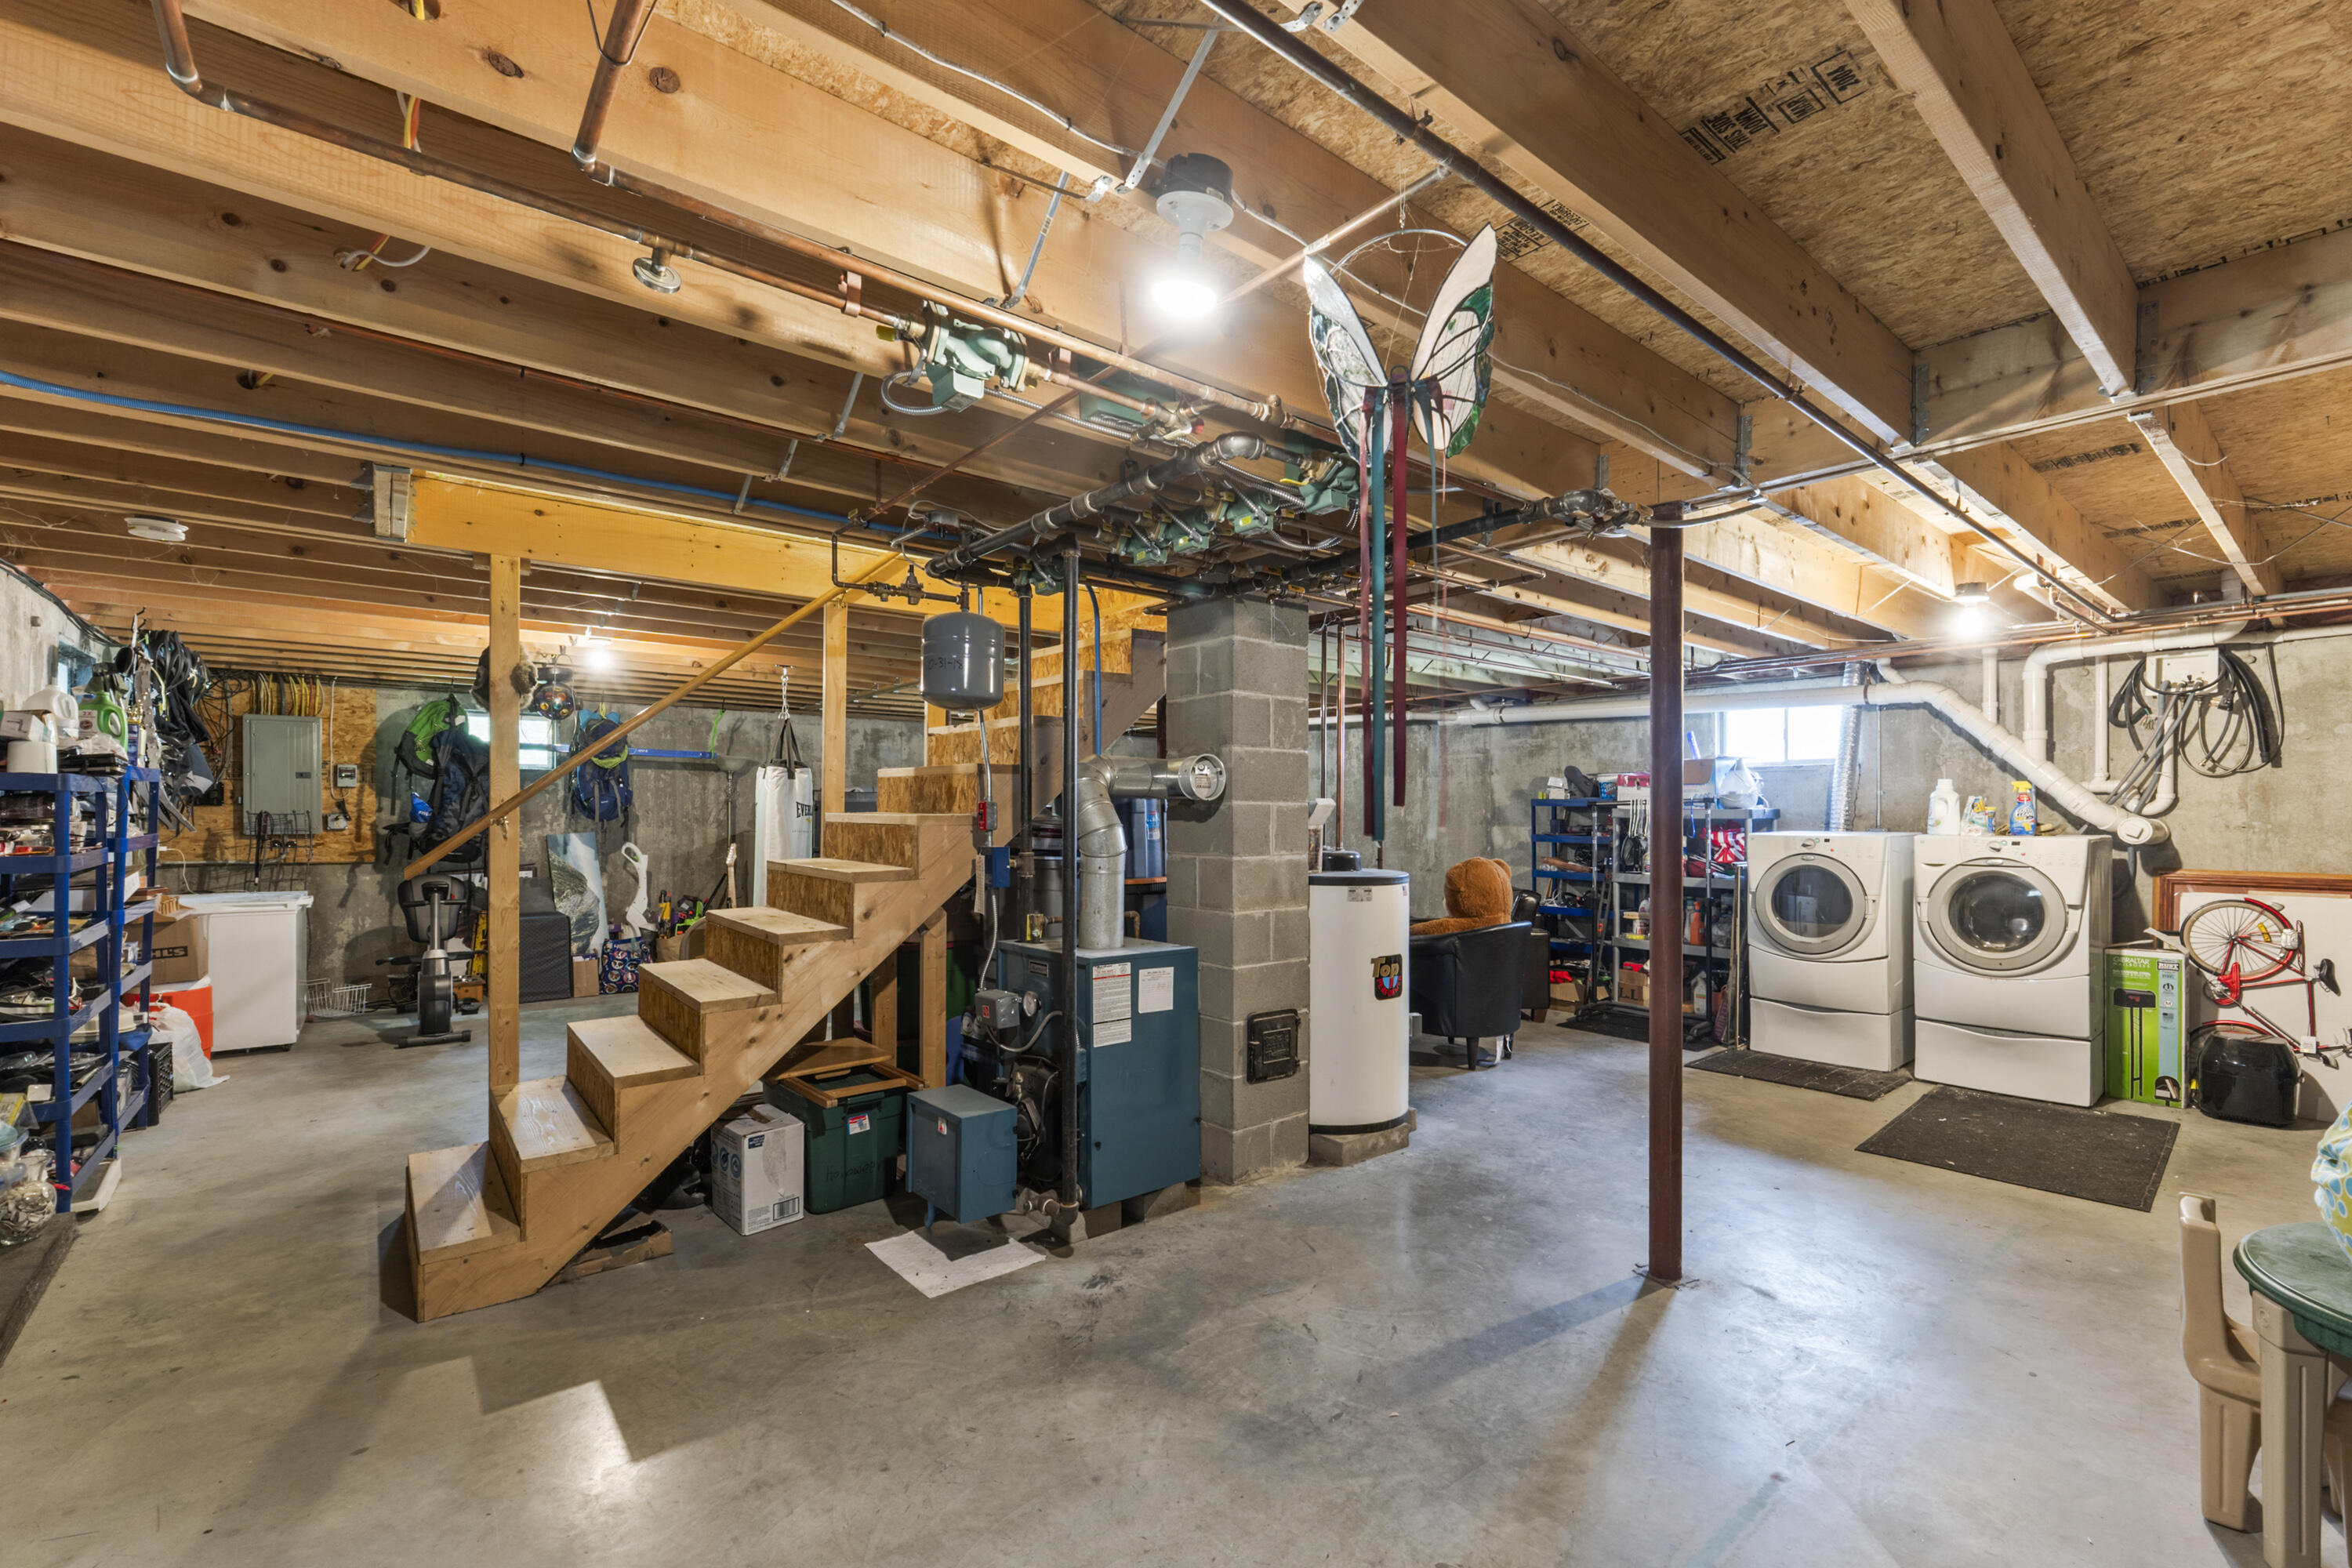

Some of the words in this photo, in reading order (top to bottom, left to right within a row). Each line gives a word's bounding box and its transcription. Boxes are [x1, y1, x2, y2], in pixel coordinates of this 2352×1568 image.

[1827, 64, 1861, 93] 2004
[1787, 95, 1817, 118] MAR
[1705, 111, 1737, 134] SIDE
[1733, 107, 1769, 135] DOWN
[1724, 129, 1752, 151] THIS
[1370, 956, 1399, 978] Top
